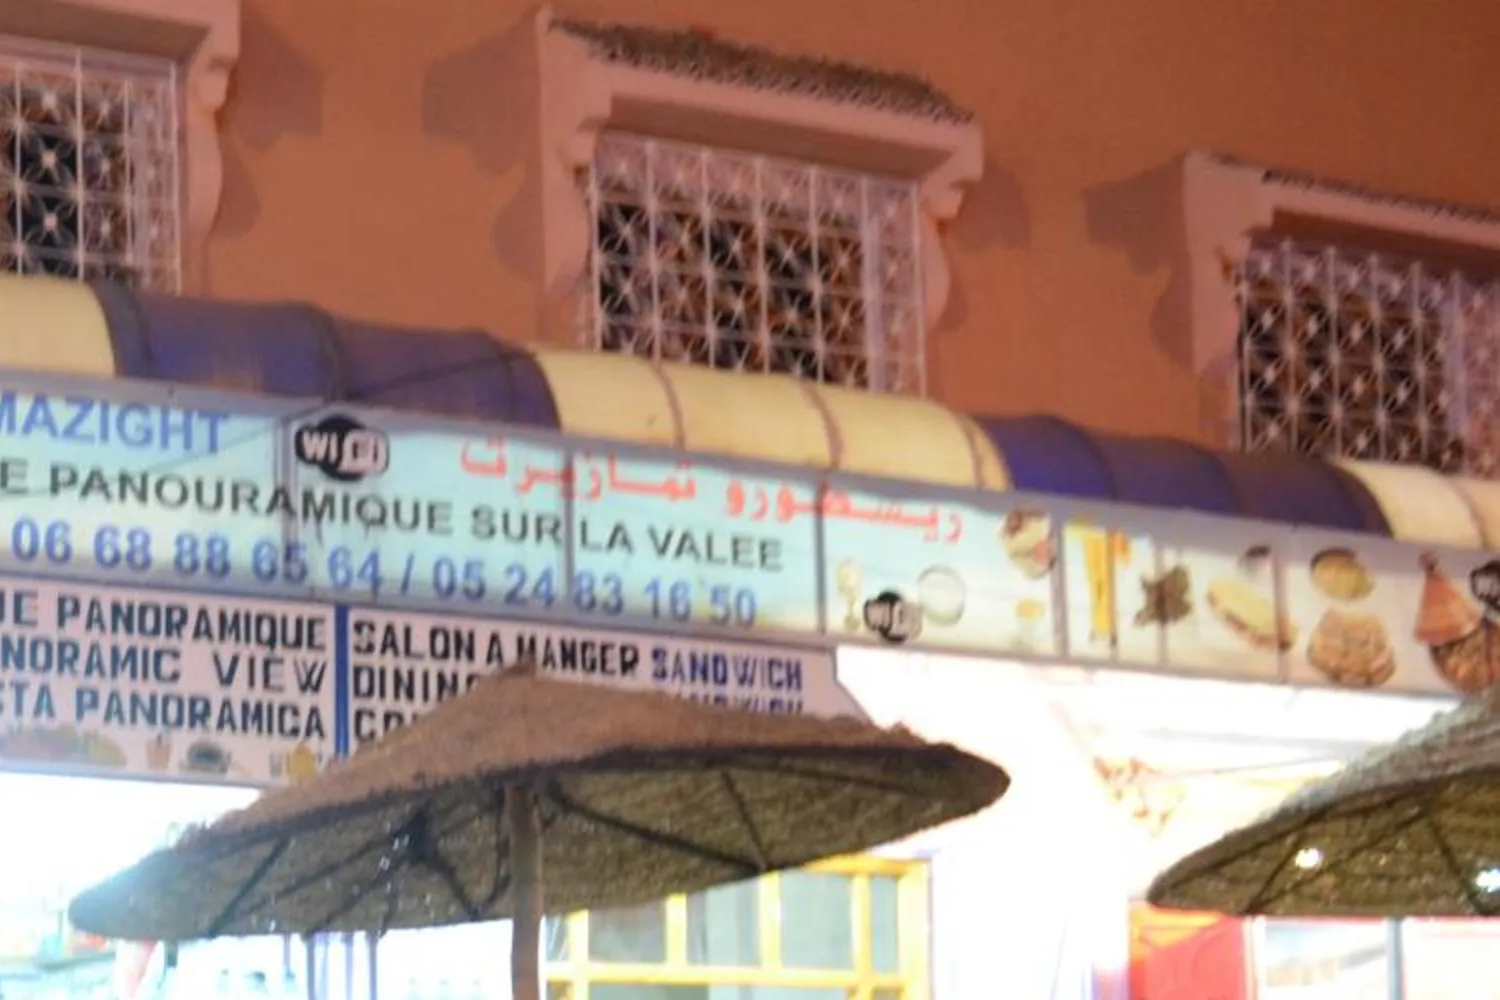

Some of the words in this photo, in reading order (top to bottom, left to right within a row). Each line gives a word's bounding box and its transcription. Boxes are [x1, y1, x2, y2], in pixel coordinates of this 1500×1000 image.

[50, 464, 452, 535] PANOURAMIQUE
[471, 504, 564, 546] SUR
[580, 520, 634, 555] LA
[650, 526, 783, 571] VALEE
[12, 515, 72, 564] 06
[94, 525, 153, 570] 68
[174, 532, 231, 579] 88
[328, 545, 382, 596] 64
[432, 557, 486, 600] 05
[504, 563, 556, 606] 24
[645, 575, 692, 622] 16
[709, 583, 757, 628] 50
[57, 594, 326, 652] PANORAMIQUE
[213, 652, 327, 694] VIEW
[353, 620, 475, 664] SALON
[486, 631, 504, 666] A
[516, 633, 640, 677] MANGER
[652, 646, 803, 692] SANDWICH
[75, 686, 326, 739] PANORAMICA
